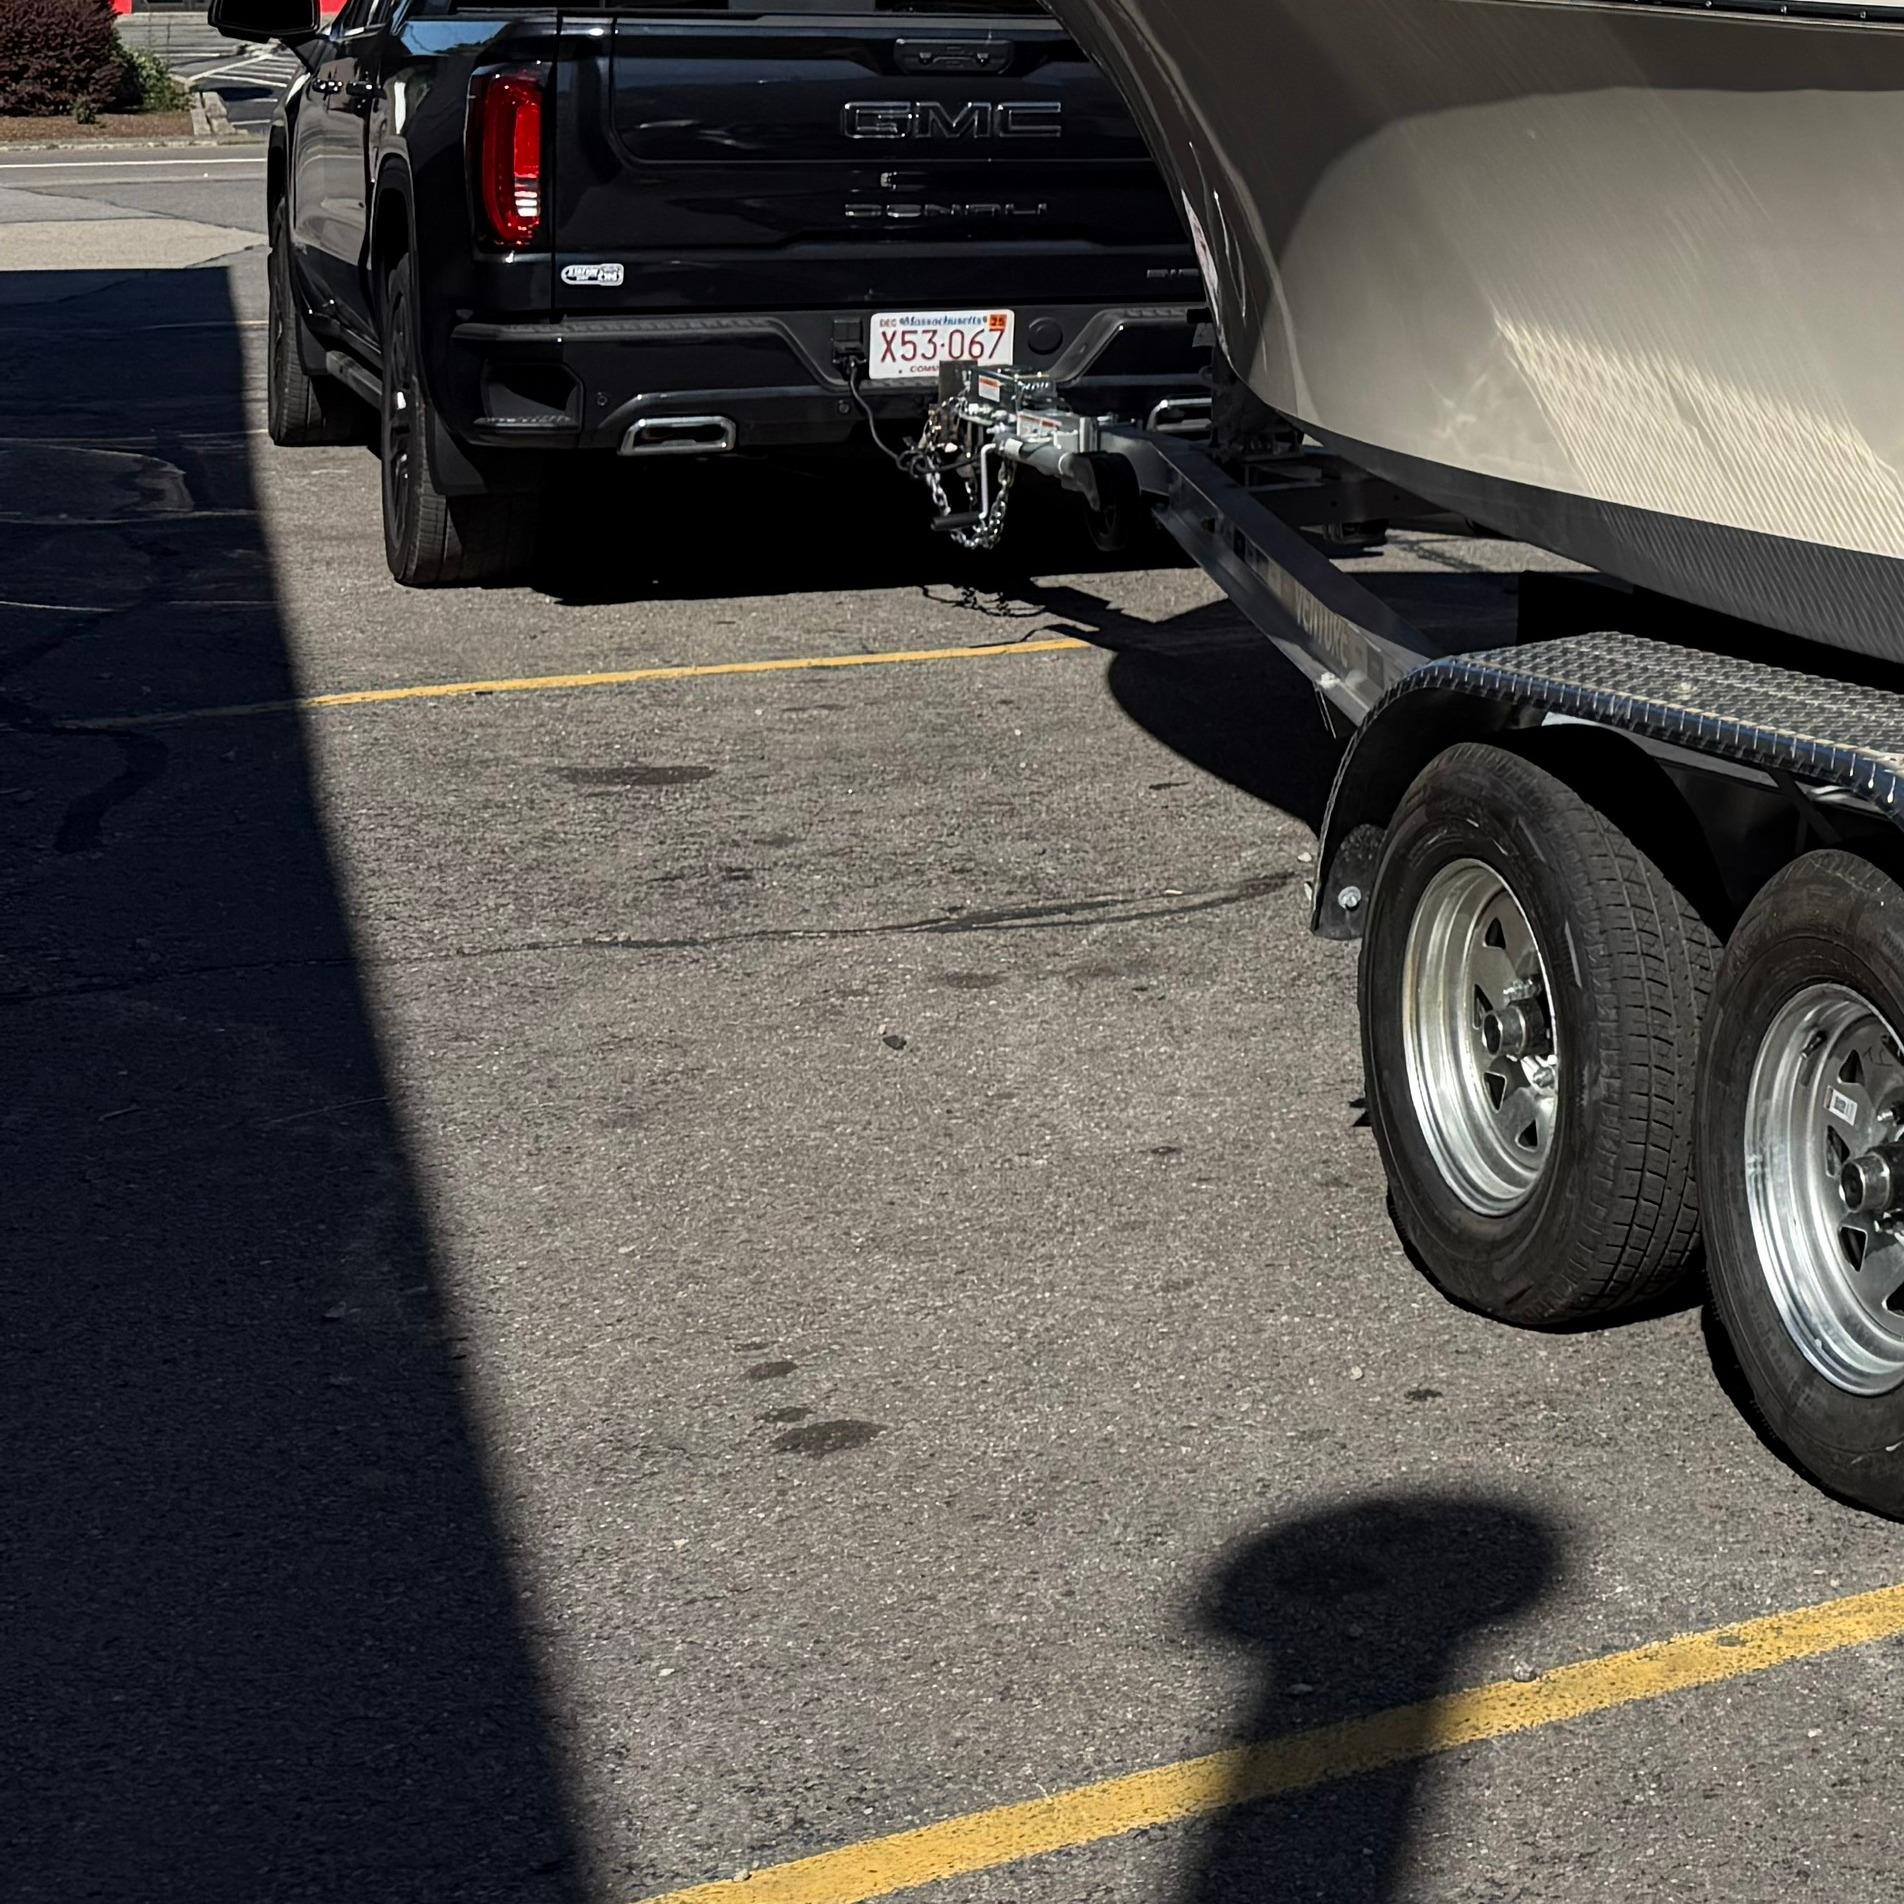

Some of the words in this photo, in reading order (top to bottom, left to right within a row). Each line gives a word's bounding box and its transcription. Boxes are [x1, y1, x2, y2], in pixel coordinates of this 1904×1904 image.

[842, 100, 1062, 139] GMC
[845, 202, 1048, 218] DENALI
[879, 318, 897, 328] DEC
[901, 314, 984, 328] Massachusetts
